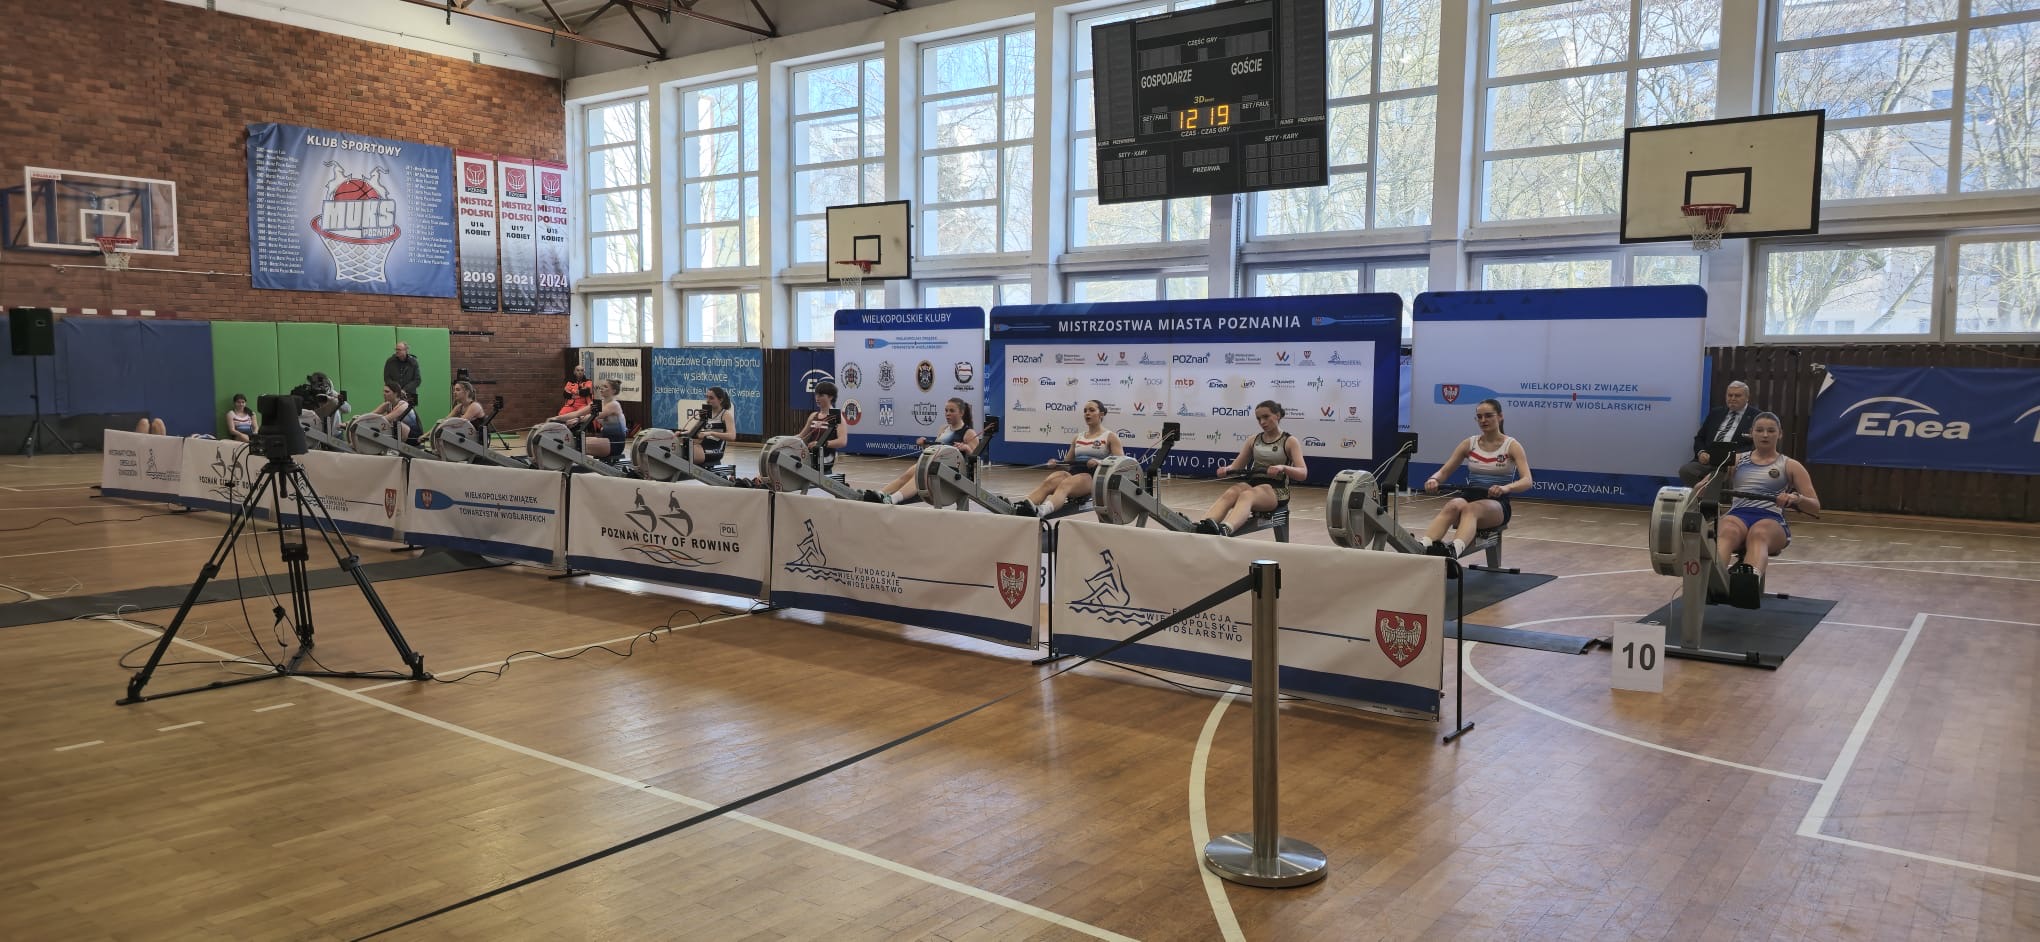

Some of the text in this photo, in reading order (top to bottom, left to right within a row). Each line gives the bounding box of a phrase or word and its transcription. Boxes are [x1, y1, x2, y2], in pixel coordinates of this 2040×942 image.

[1231, 56, 1262, 75] GOŚCIE
[1141, 69, 1192, 89] GOSPODARZE
[1179, 104, 1229, 129] 12 19
[307, 135, 401, 156] KLUB SPORTOWY
[460, 197, 493, 207] MISTRZ
[502, 201, 532, 211] MISTRZ
[323, 200, 395, 231] MUKS
[461, 208, 493, 218] POLSKI
[537, 205, 567, 215] MISTRZ
[502, 212, 532, 222] POLSKI
[538, 215, 567, 225] POLSKI
[507, 232, 530, 240] KOBIET
[541, 235, 564, 243] KOBIET
[464, 271, 495, 283] 2019
[504, 274, 534, 285] 2021
[540, 273, 568, 287] 2024
[862, 313, 951, 324] WIELKOPOLSKIE KLUBY
[1058, 315, 1301, 332] MISTRZOSTWA MIASTA POZNANIA
[702, 356, 732, 366] Centrum
[735, 357, 760, 368] Sportu
[691, 371, 728, 382] siatkówce
[1012, 376, 1029, 384] mtp
[1175, 378, 1194, 387] mtp
[737, 389, 760, 398] wspiera
[1520, 383, 1638, 393] WIELKOPOLSKI ZWIĄZEK
[1507, 400, 1651, 411] TOWARZYSTW WIOŚLARSKICH
[1856, 412, 1970, 439] Enea
[1118, 431, 1136, 439] Enea
[465, 491, 538, 504] WIELKOPOLSKI ZWIĄZEK
[459, 507, 546, 523] TOWARZYSTW WIOŚLARSKICH
[722, 526, 736, 534] POL
[601, 526, 740, 552] POZNAŃ CITY OF ROWING
[854, 566, 896, 578] FUNDACJA
[1684, 561, 1700, 576] 10
[838, 572, 900, 586] WIELKOPOLSKIE
[1173, 608, 1231, 623] FDACJA
[1147, 612, 1238, 632] WIEOPOLSKIE
[1622, 641, 1656, 671] 10
